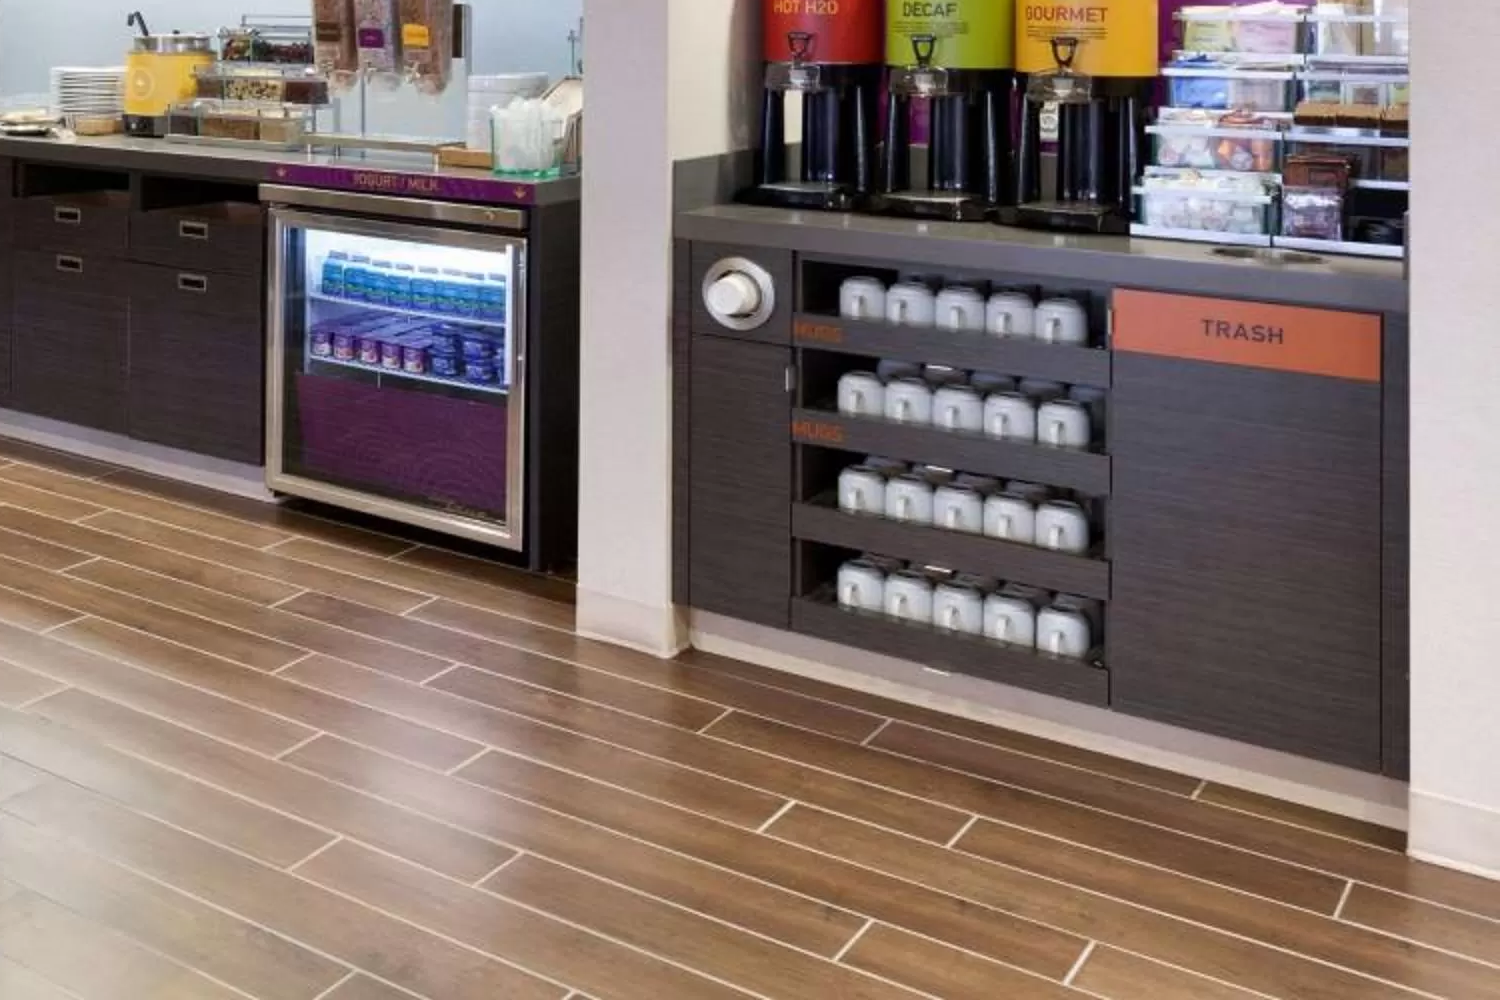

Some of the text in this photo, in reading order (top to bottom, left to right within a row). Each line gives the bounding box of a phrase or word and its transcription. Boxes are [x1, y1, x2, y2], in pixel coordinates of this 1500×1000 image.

[773, 0, 800, 15] HOT
[902, 1, 957, 18] DECAF
[1025, 5, 1109, 22] GOURMET
[1201, 318, 1284, 345] TRASH
